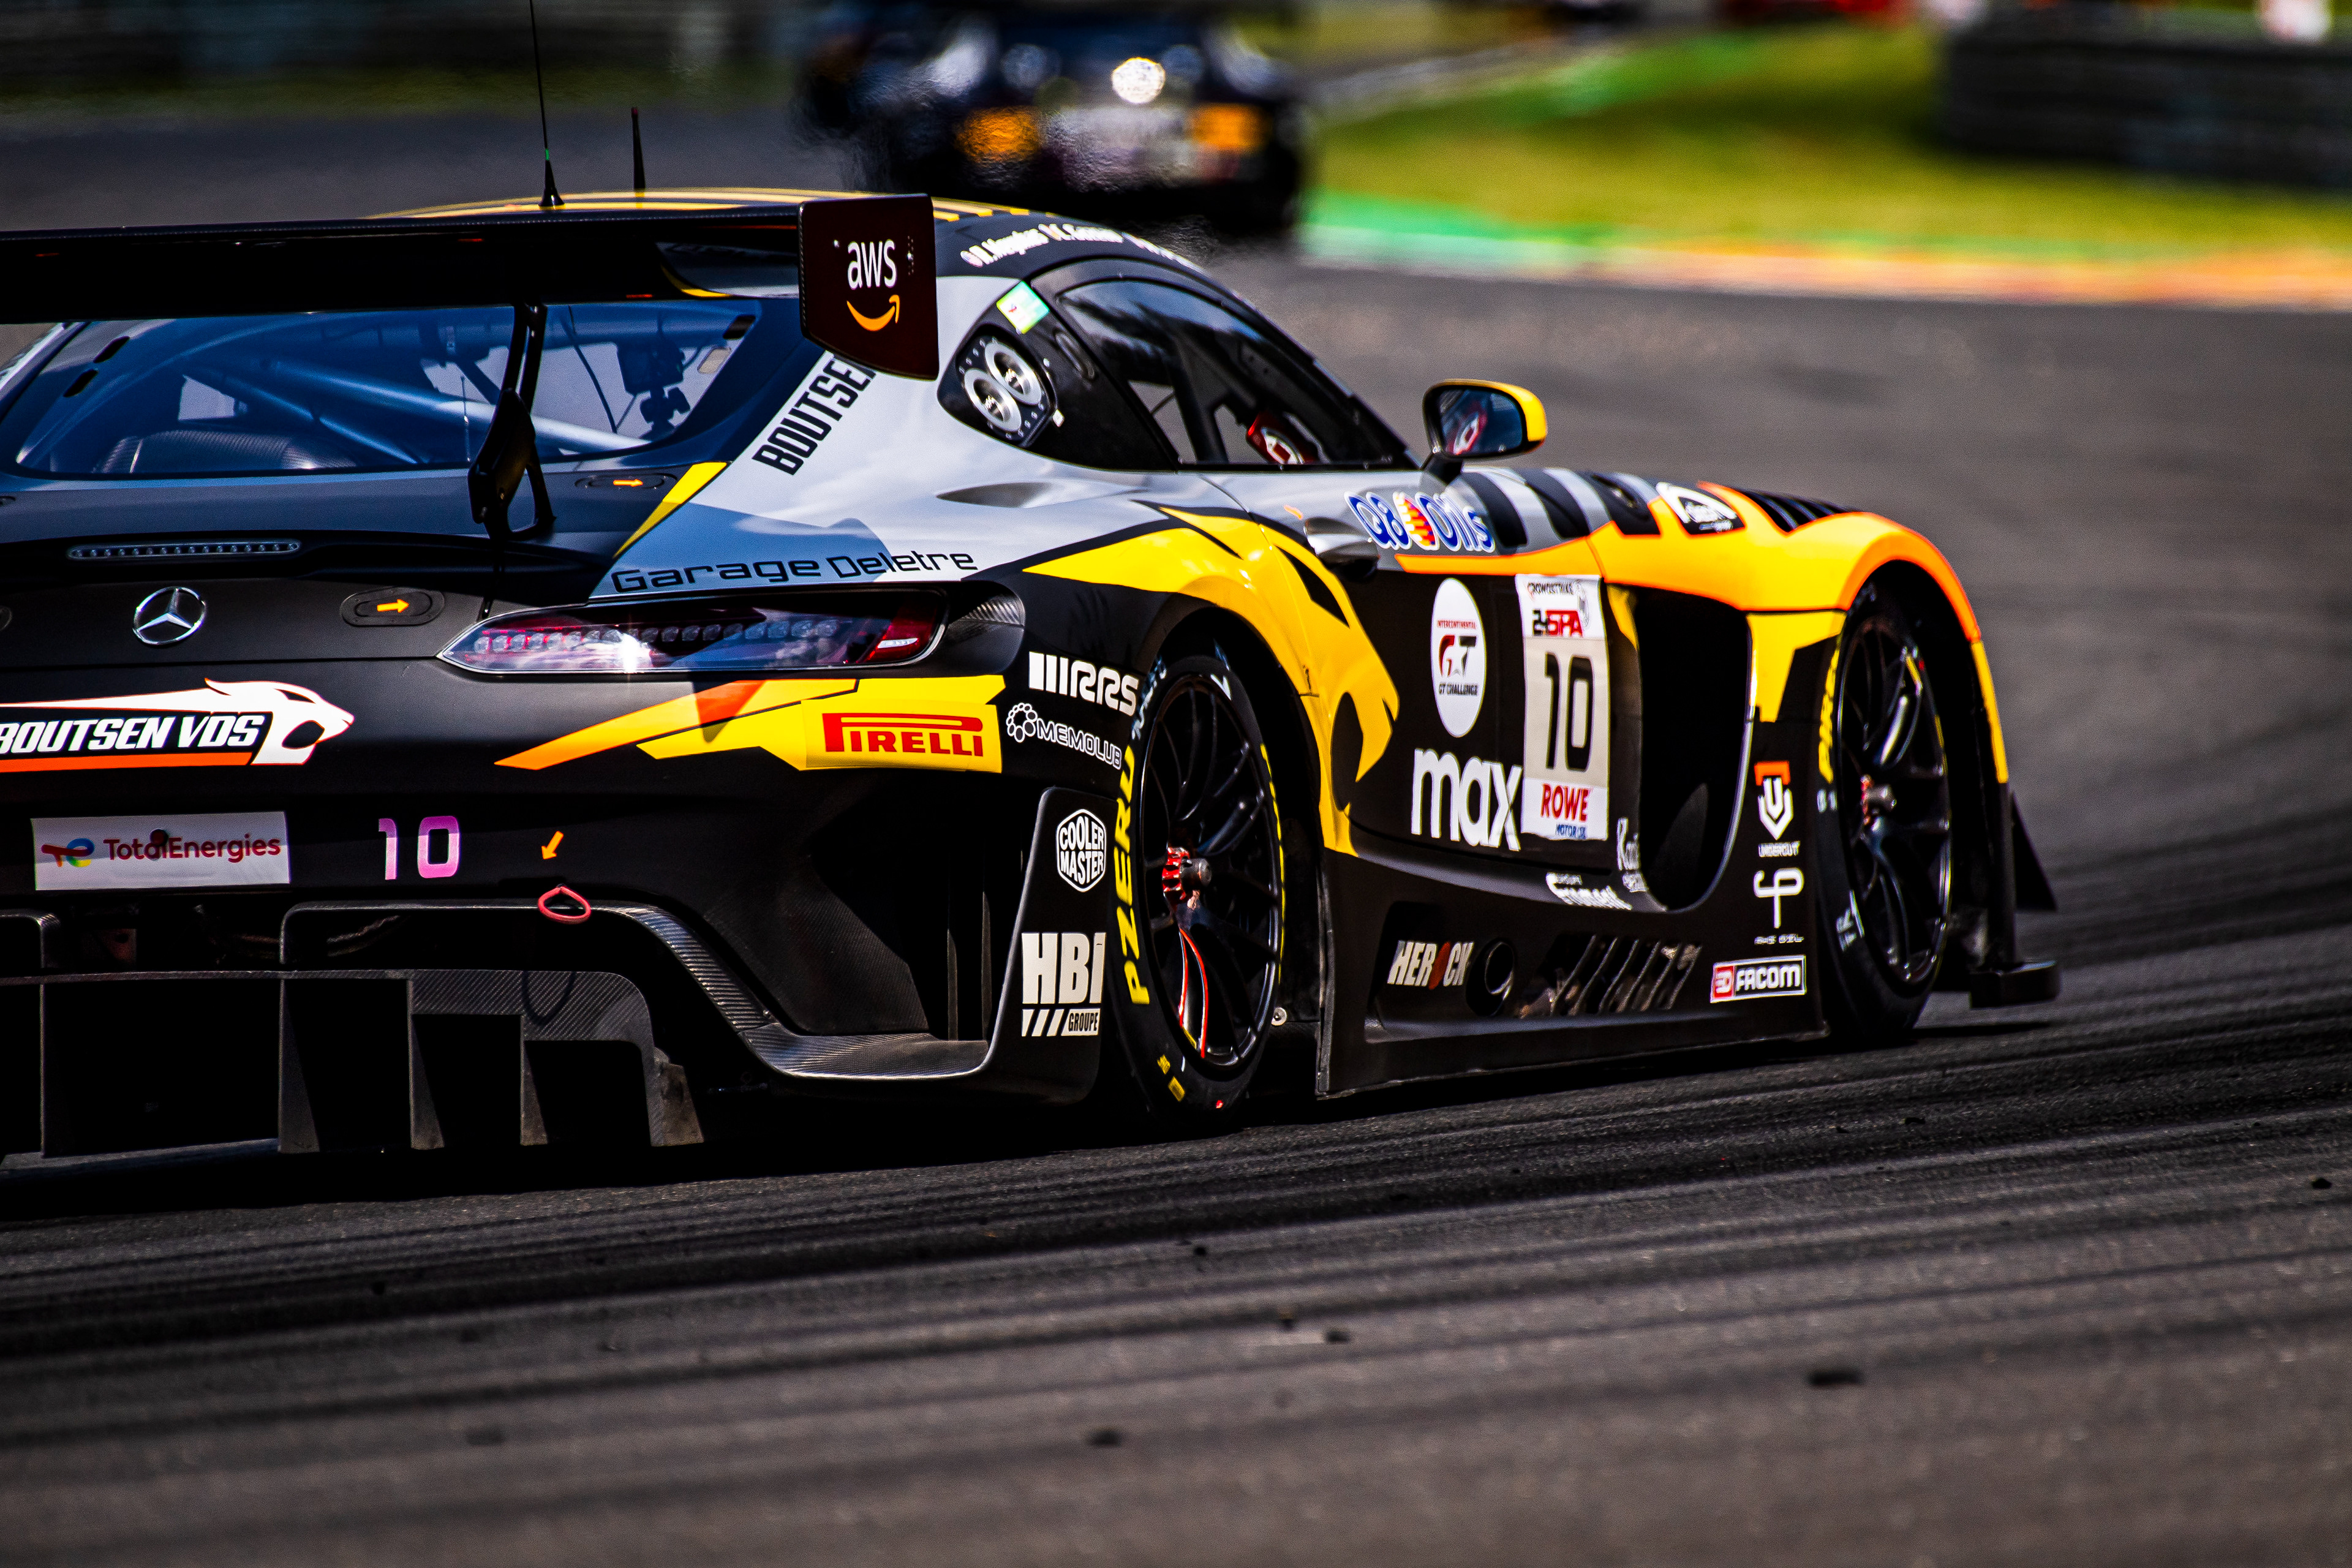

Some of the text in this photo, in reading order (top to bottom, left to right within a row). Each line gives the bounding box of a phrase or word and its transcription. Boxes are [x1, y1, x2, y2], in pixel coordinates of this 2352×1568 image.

[848, 239, 897, 290] aws
[1344, 492, 1412, 549] Q8
[611, 550, 978, 594] Garage Deletre
[1437, 619, 1477, 630] INTERCONTINENTAL
[1070, 660, 1139, 717] RRS
[1447, 683, 1478, 696] CHALLENGE
[1545, 652, 1594, 772] 10
[0, 715, 265, 755] BOUTSEN VDS
[822, 713, 984, 757] PIRELLI
[1036, 718, 1122, 770] MEMOLUB
[1411, 748, 1523, 851] max
[1540, 783, 1589, 822] ROWE
[103, 834, 281, 863] TotalEnergies
[378, 815, 461, 881] 10
[1060, 816, 1104, 850] COOLER
[1060, 851, 1104, 885] MASTER
[1021, 932, 1106, 1005] HBI
[1736, 964, 1801, 992] FACOM
[1068, 1012, 1098, 1031] GROUPE
